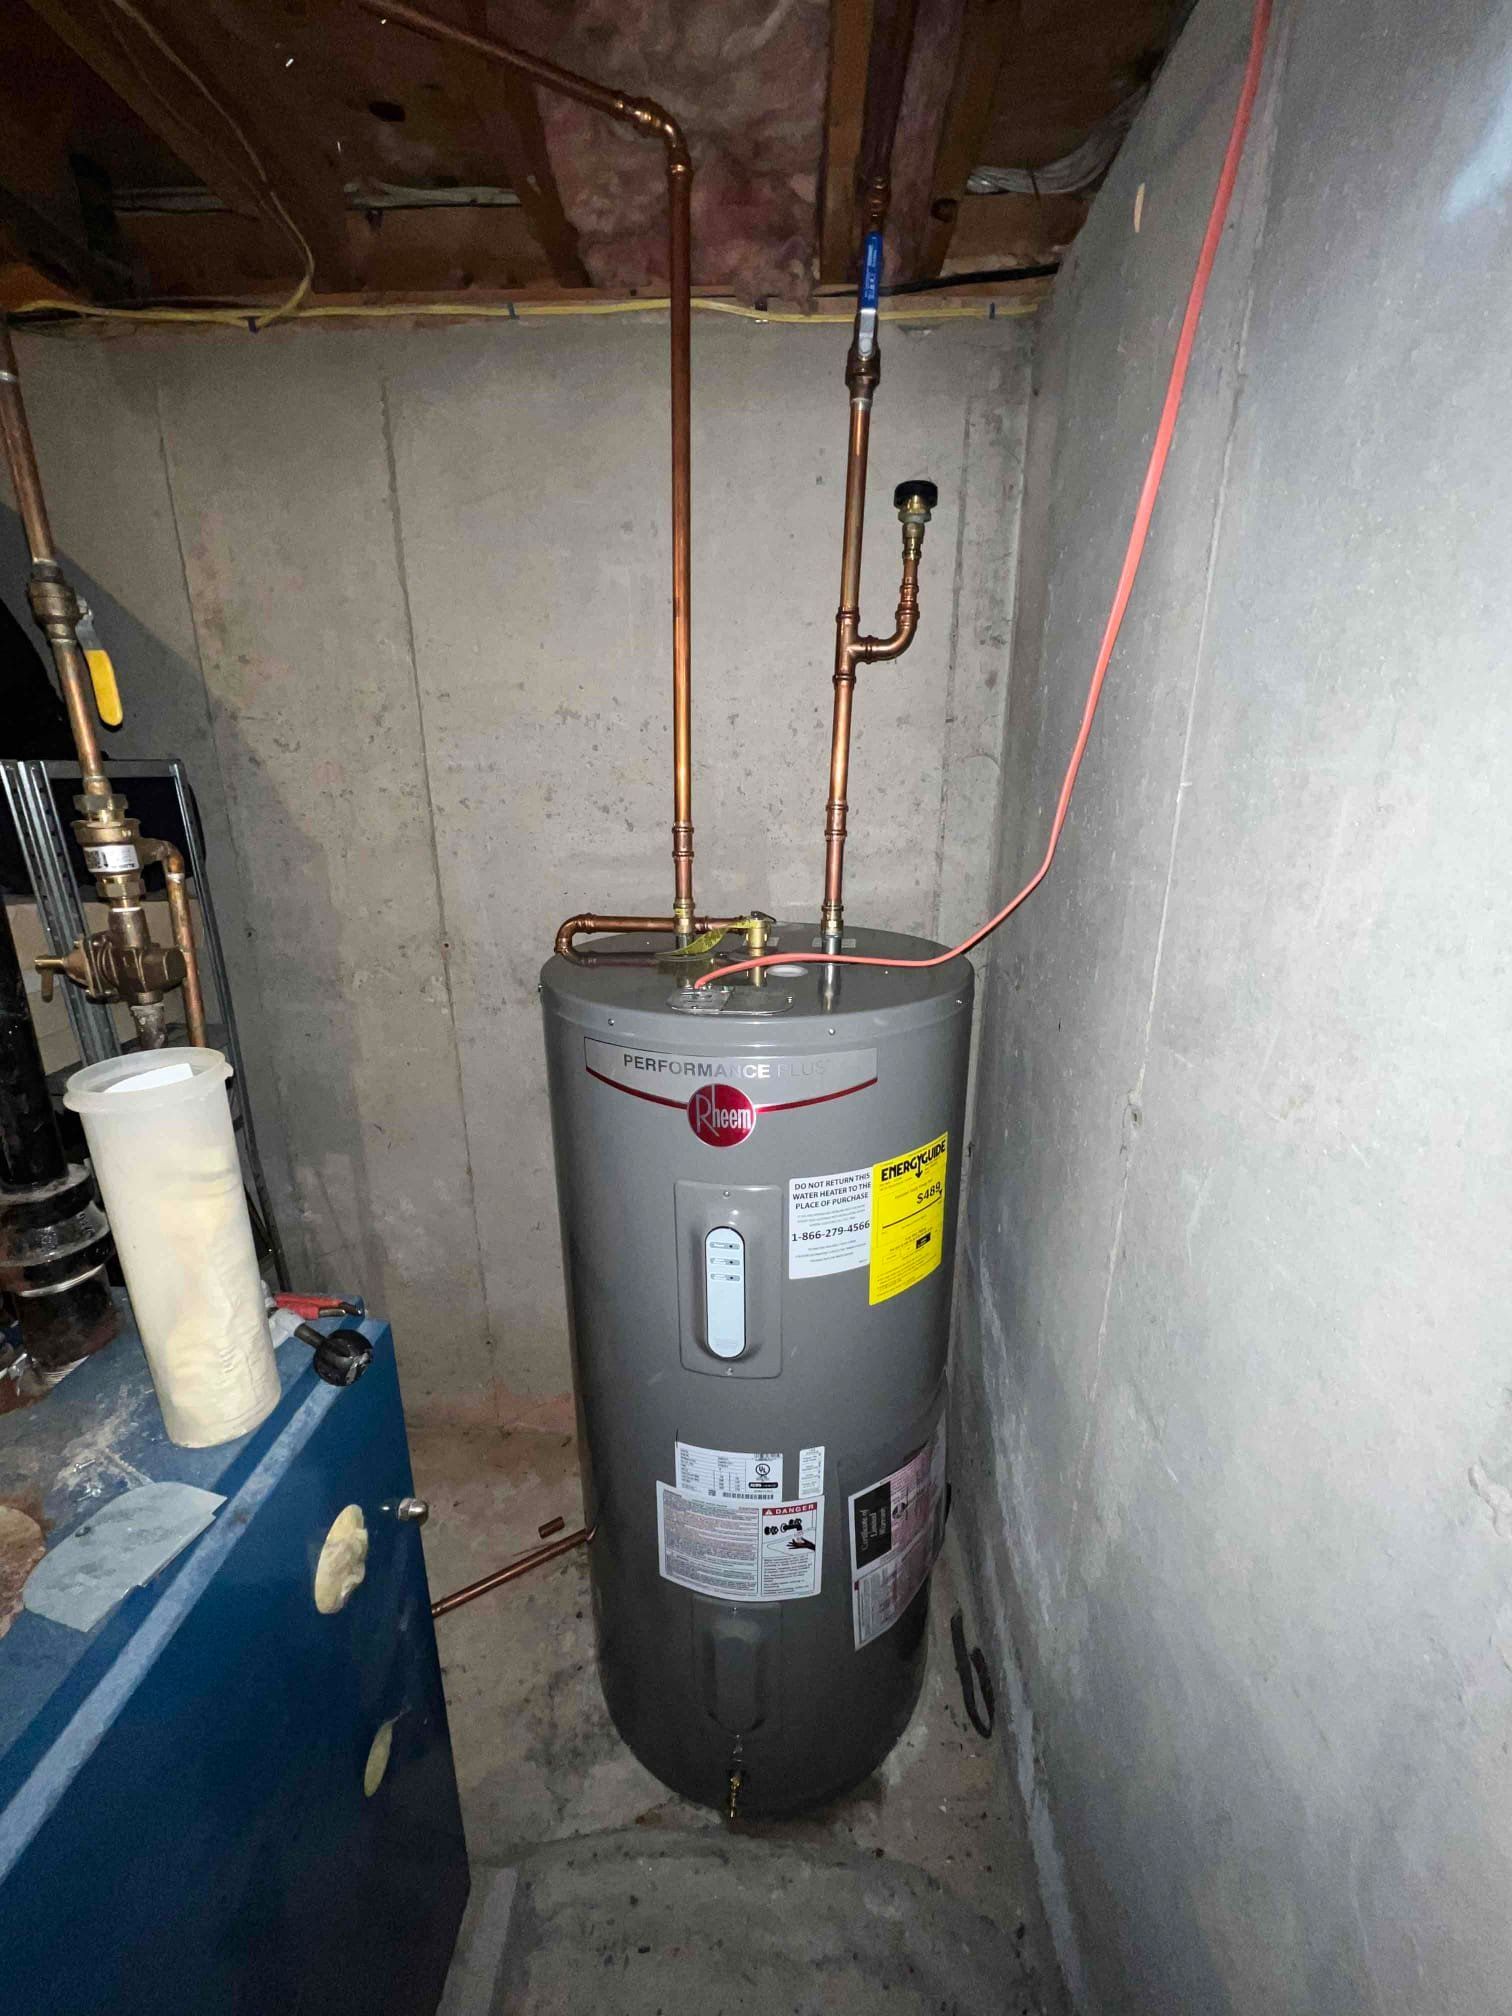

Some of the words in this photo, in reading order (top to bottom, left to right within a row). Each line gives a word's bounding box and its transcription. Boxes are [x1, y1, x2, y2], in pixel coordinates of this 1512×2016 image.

[624, 1054, 770, 1079] PERFORMANCE
[777, 1061, 825, 1078] PLUS
[696, 1084, 752, 1137] Rheem
[808, 1181, 824, 1189] NOT
[825, 1176, 854, 1187] RETURN
[855, 1172, 870, 1181] THIS
[792, 1190, 818, 1200] WATER
[820, 1187, 847, 1197] HEATER
[859, 1181, 871, 1189] THE
[795, 1201, 819, 1210] PLACE
[820, 1199, 830, 1207] OF
[832, 1192, 868, 1205] PURCHASE
[792, 1220, 870, 1242] 1-866-279-4566
[775, 1504, 814, 1515] DANGER
